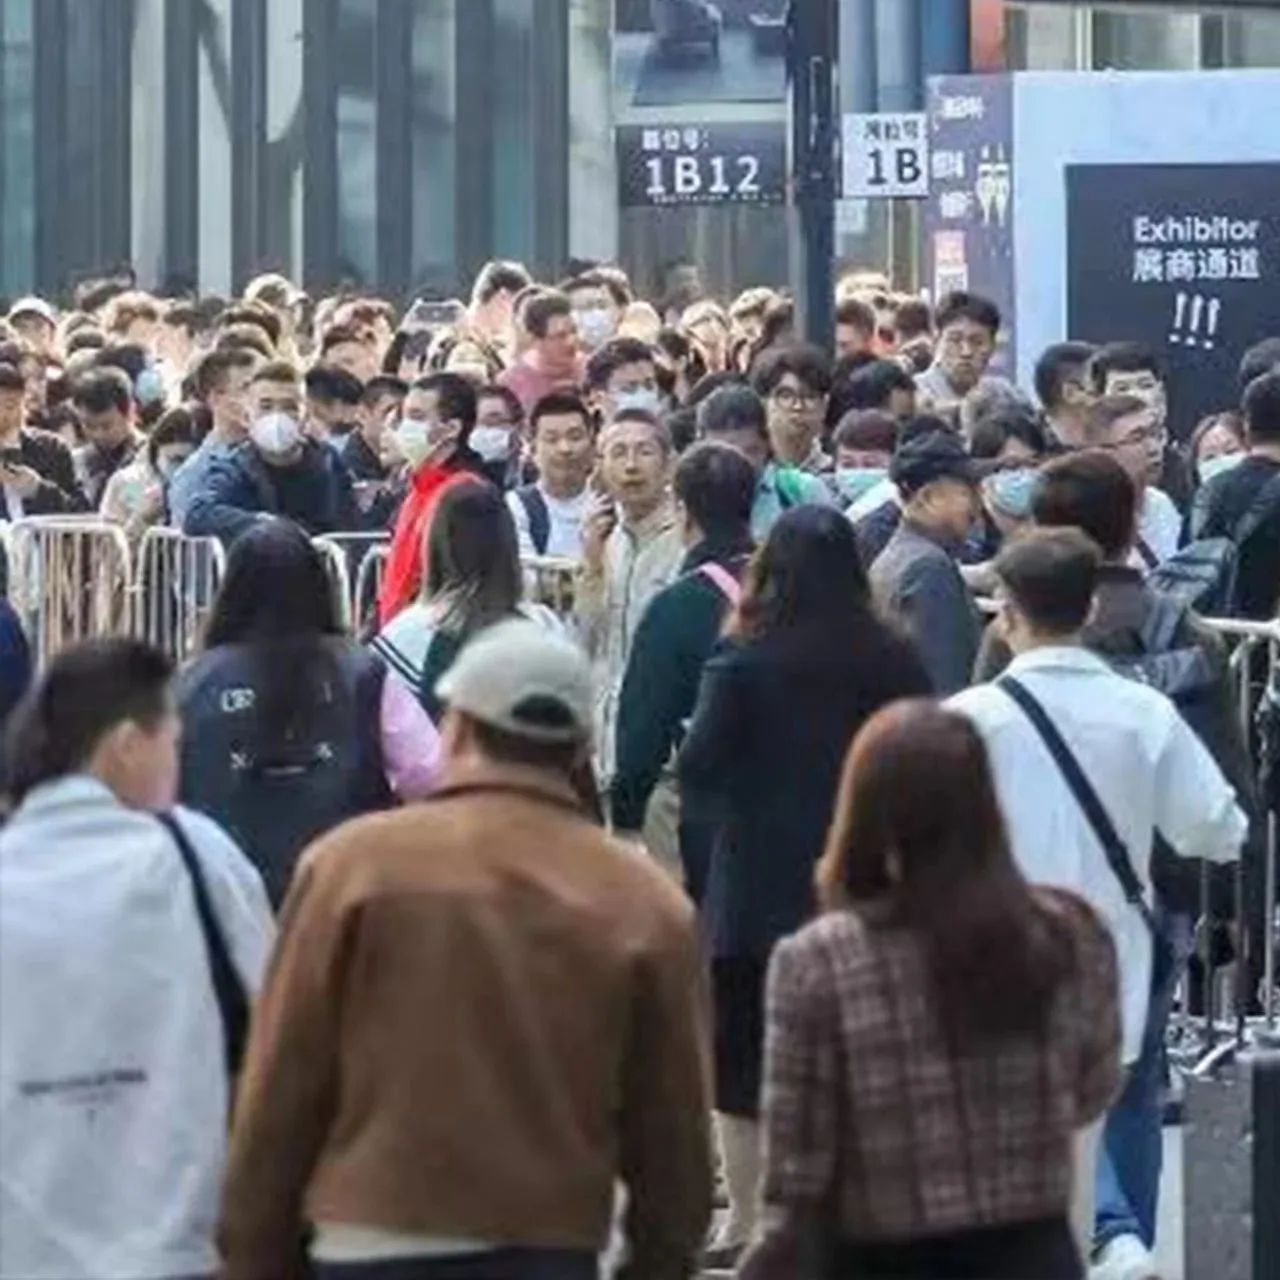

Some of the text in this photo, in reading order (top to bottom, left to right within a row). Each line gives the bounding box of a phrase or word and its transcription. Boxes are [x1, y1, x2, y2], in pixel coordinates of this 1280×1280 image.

[645, 155, 760, 194] 1B12
[867, 147, 922, 186] 1B
[1133, 216, 1260, 243] Exhibitor
[1132, 247, 1260, 282] 展商通道
